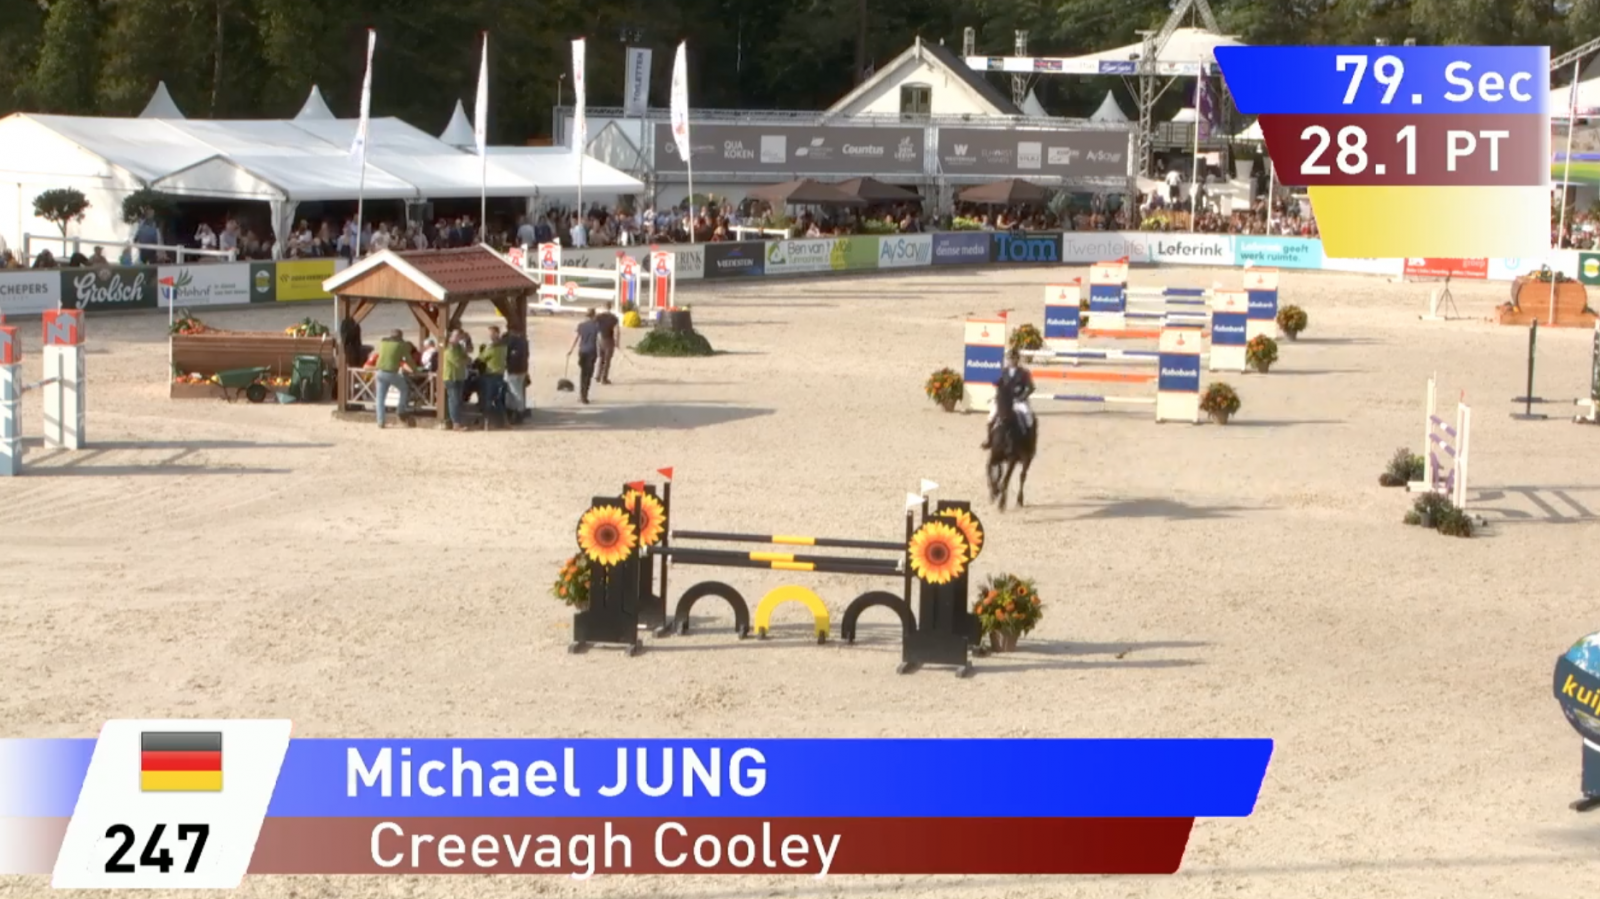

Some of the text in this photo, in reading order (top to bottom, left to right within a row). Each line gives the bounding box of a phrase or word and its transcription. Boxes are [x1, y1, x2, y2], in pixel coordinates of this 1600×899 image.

[842, 143, 884, 155] Countus
[994, 232, 1058, 262] Tom
[1067, 239, 1145, 256] Twentelife
[1158, 240, 1223, 257] Leferink
[73, 272, 146, 309] Grolsch
[1046, 318, 1077, 327] Rabobank
[1213, 324, 1245, 333] Rabobank
[966, 359, 1001, 369] Rabobank
[1161, 367, 1198, 378] Rabobank
